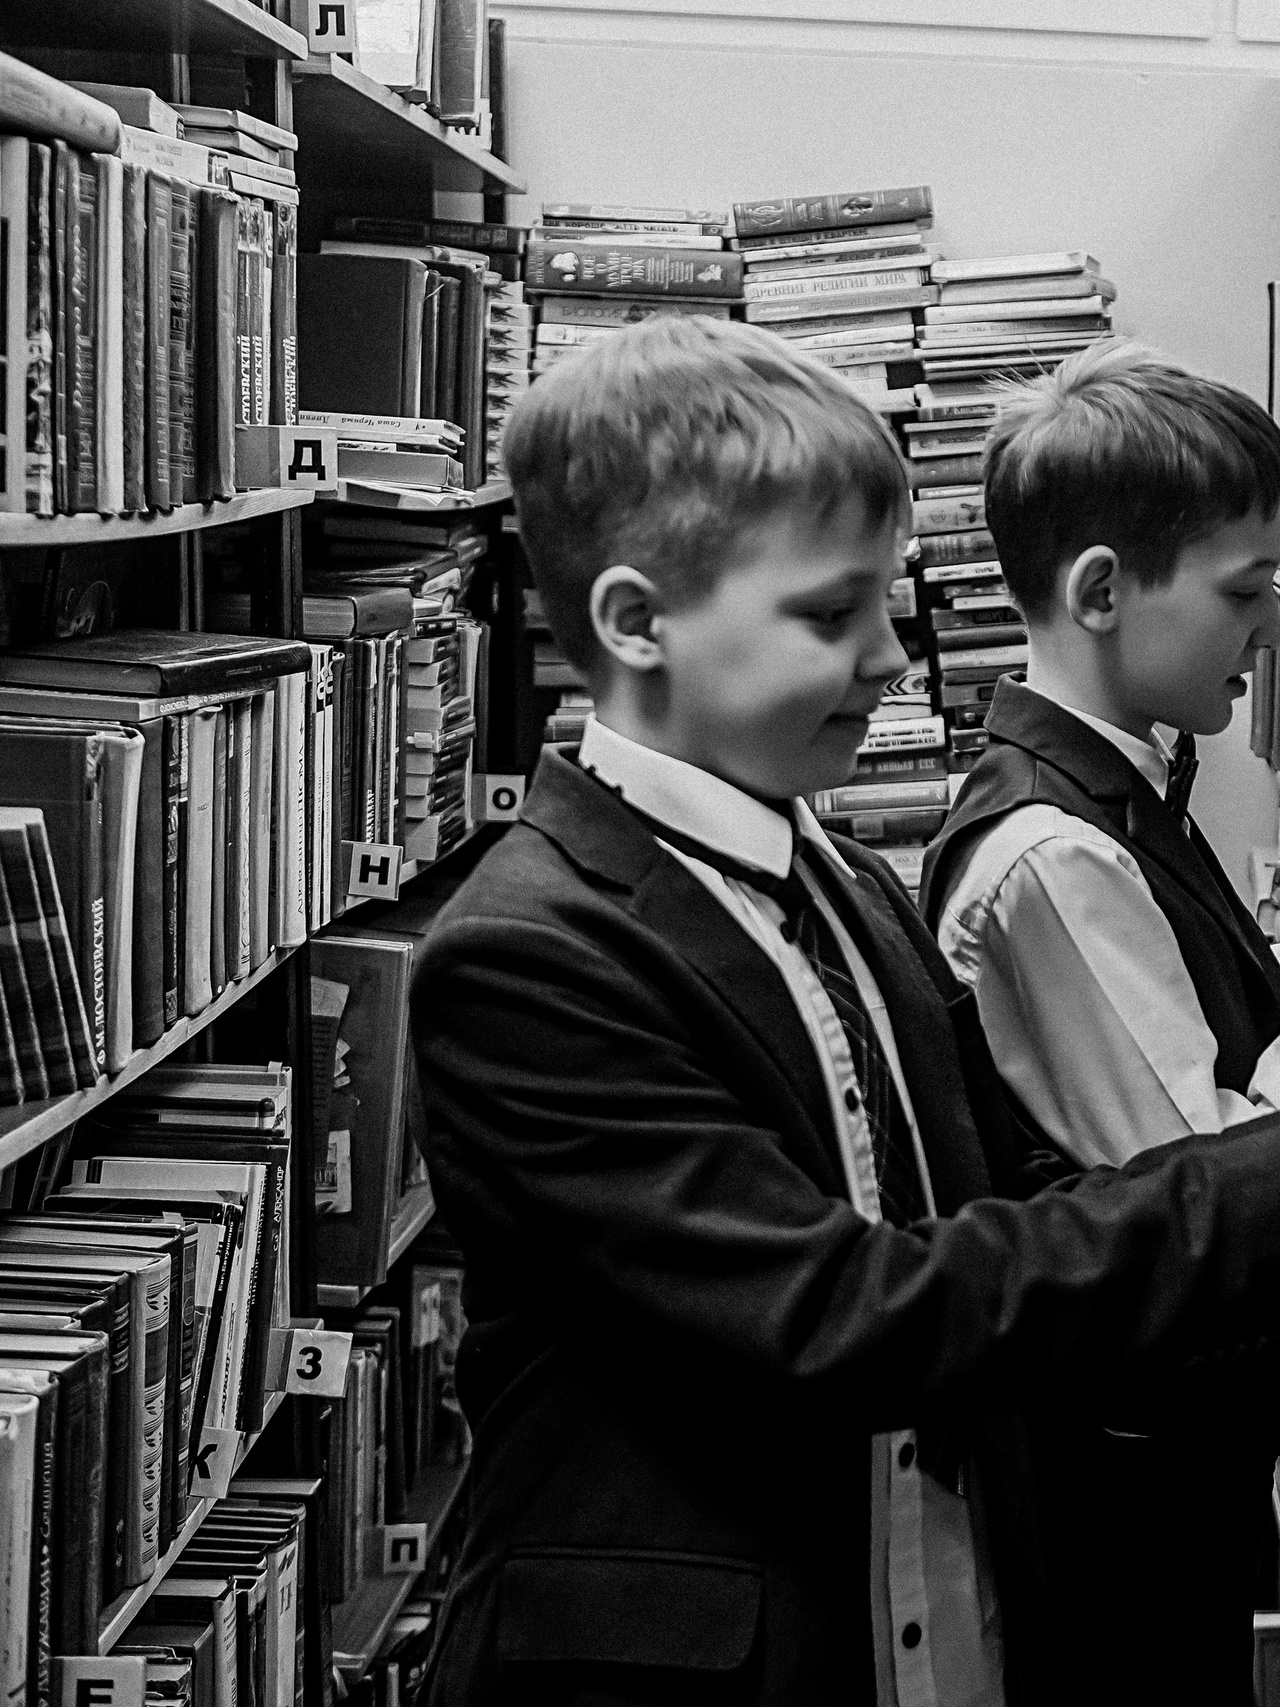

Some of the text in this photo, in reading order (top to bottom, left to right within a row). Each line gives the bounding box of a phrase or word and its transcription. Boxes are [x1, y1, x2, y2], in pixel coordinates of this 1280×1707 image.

[315, 5, 346, 36] Л
[751, 272, 907, 299] ДРЕВНИЕ РЕЛИГИИ МИРА
[236, 335, 250, 424] СТОЕВСКИЙ
[377, 419, 401, 429] Саша
[288, 440, 326, 480] Д
[494, 786, 517, 811] О
[359, 854, 389, 886] Н
[92, 898, 104, 1027] ДОСТОЕВСКИЙ
[273, 1165, 284, 1223] АЛЕКСАНДР
[221, 1221, 234, 1272] Евтушенко
[250, 1257, 261, 1305] ВИКТОР
[393, 1538, 418, 1562] П
